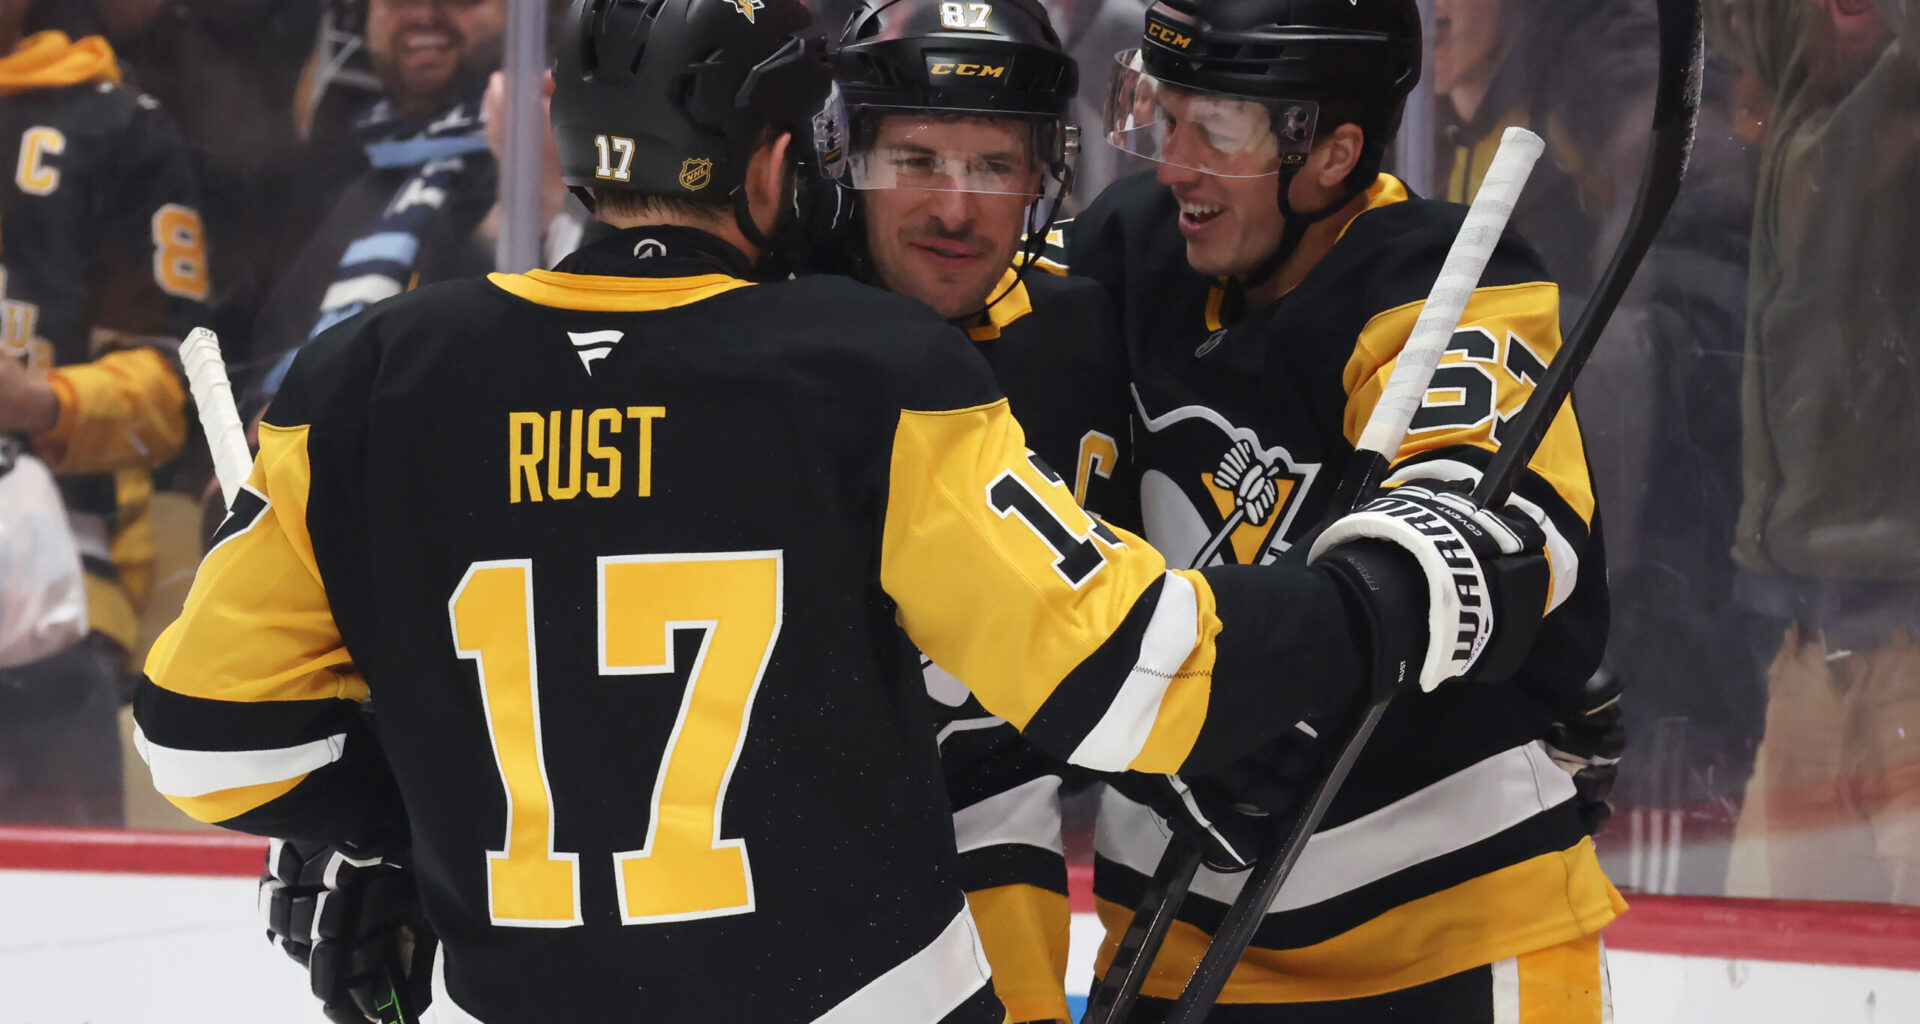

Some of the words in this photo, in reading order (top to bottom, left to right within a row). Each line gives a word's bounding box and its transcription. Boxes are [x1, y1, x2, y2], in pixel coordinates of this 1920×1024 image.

[939, 2, 991, 30] 87
[1147, 22, 1193, 50] CCM
[930, 62, 1006, 79] CCM
[15, 124, 67, 198] C
[594, 134, 636, 183] 17
[685, 168, 707, 183] NHL
[508, 405, 666, 504] RUST
[1435, 504, 1483, 537] COVERT
[1354, 500, 1483, 662] WARRIO
[448, 550, 784, 928] 17
